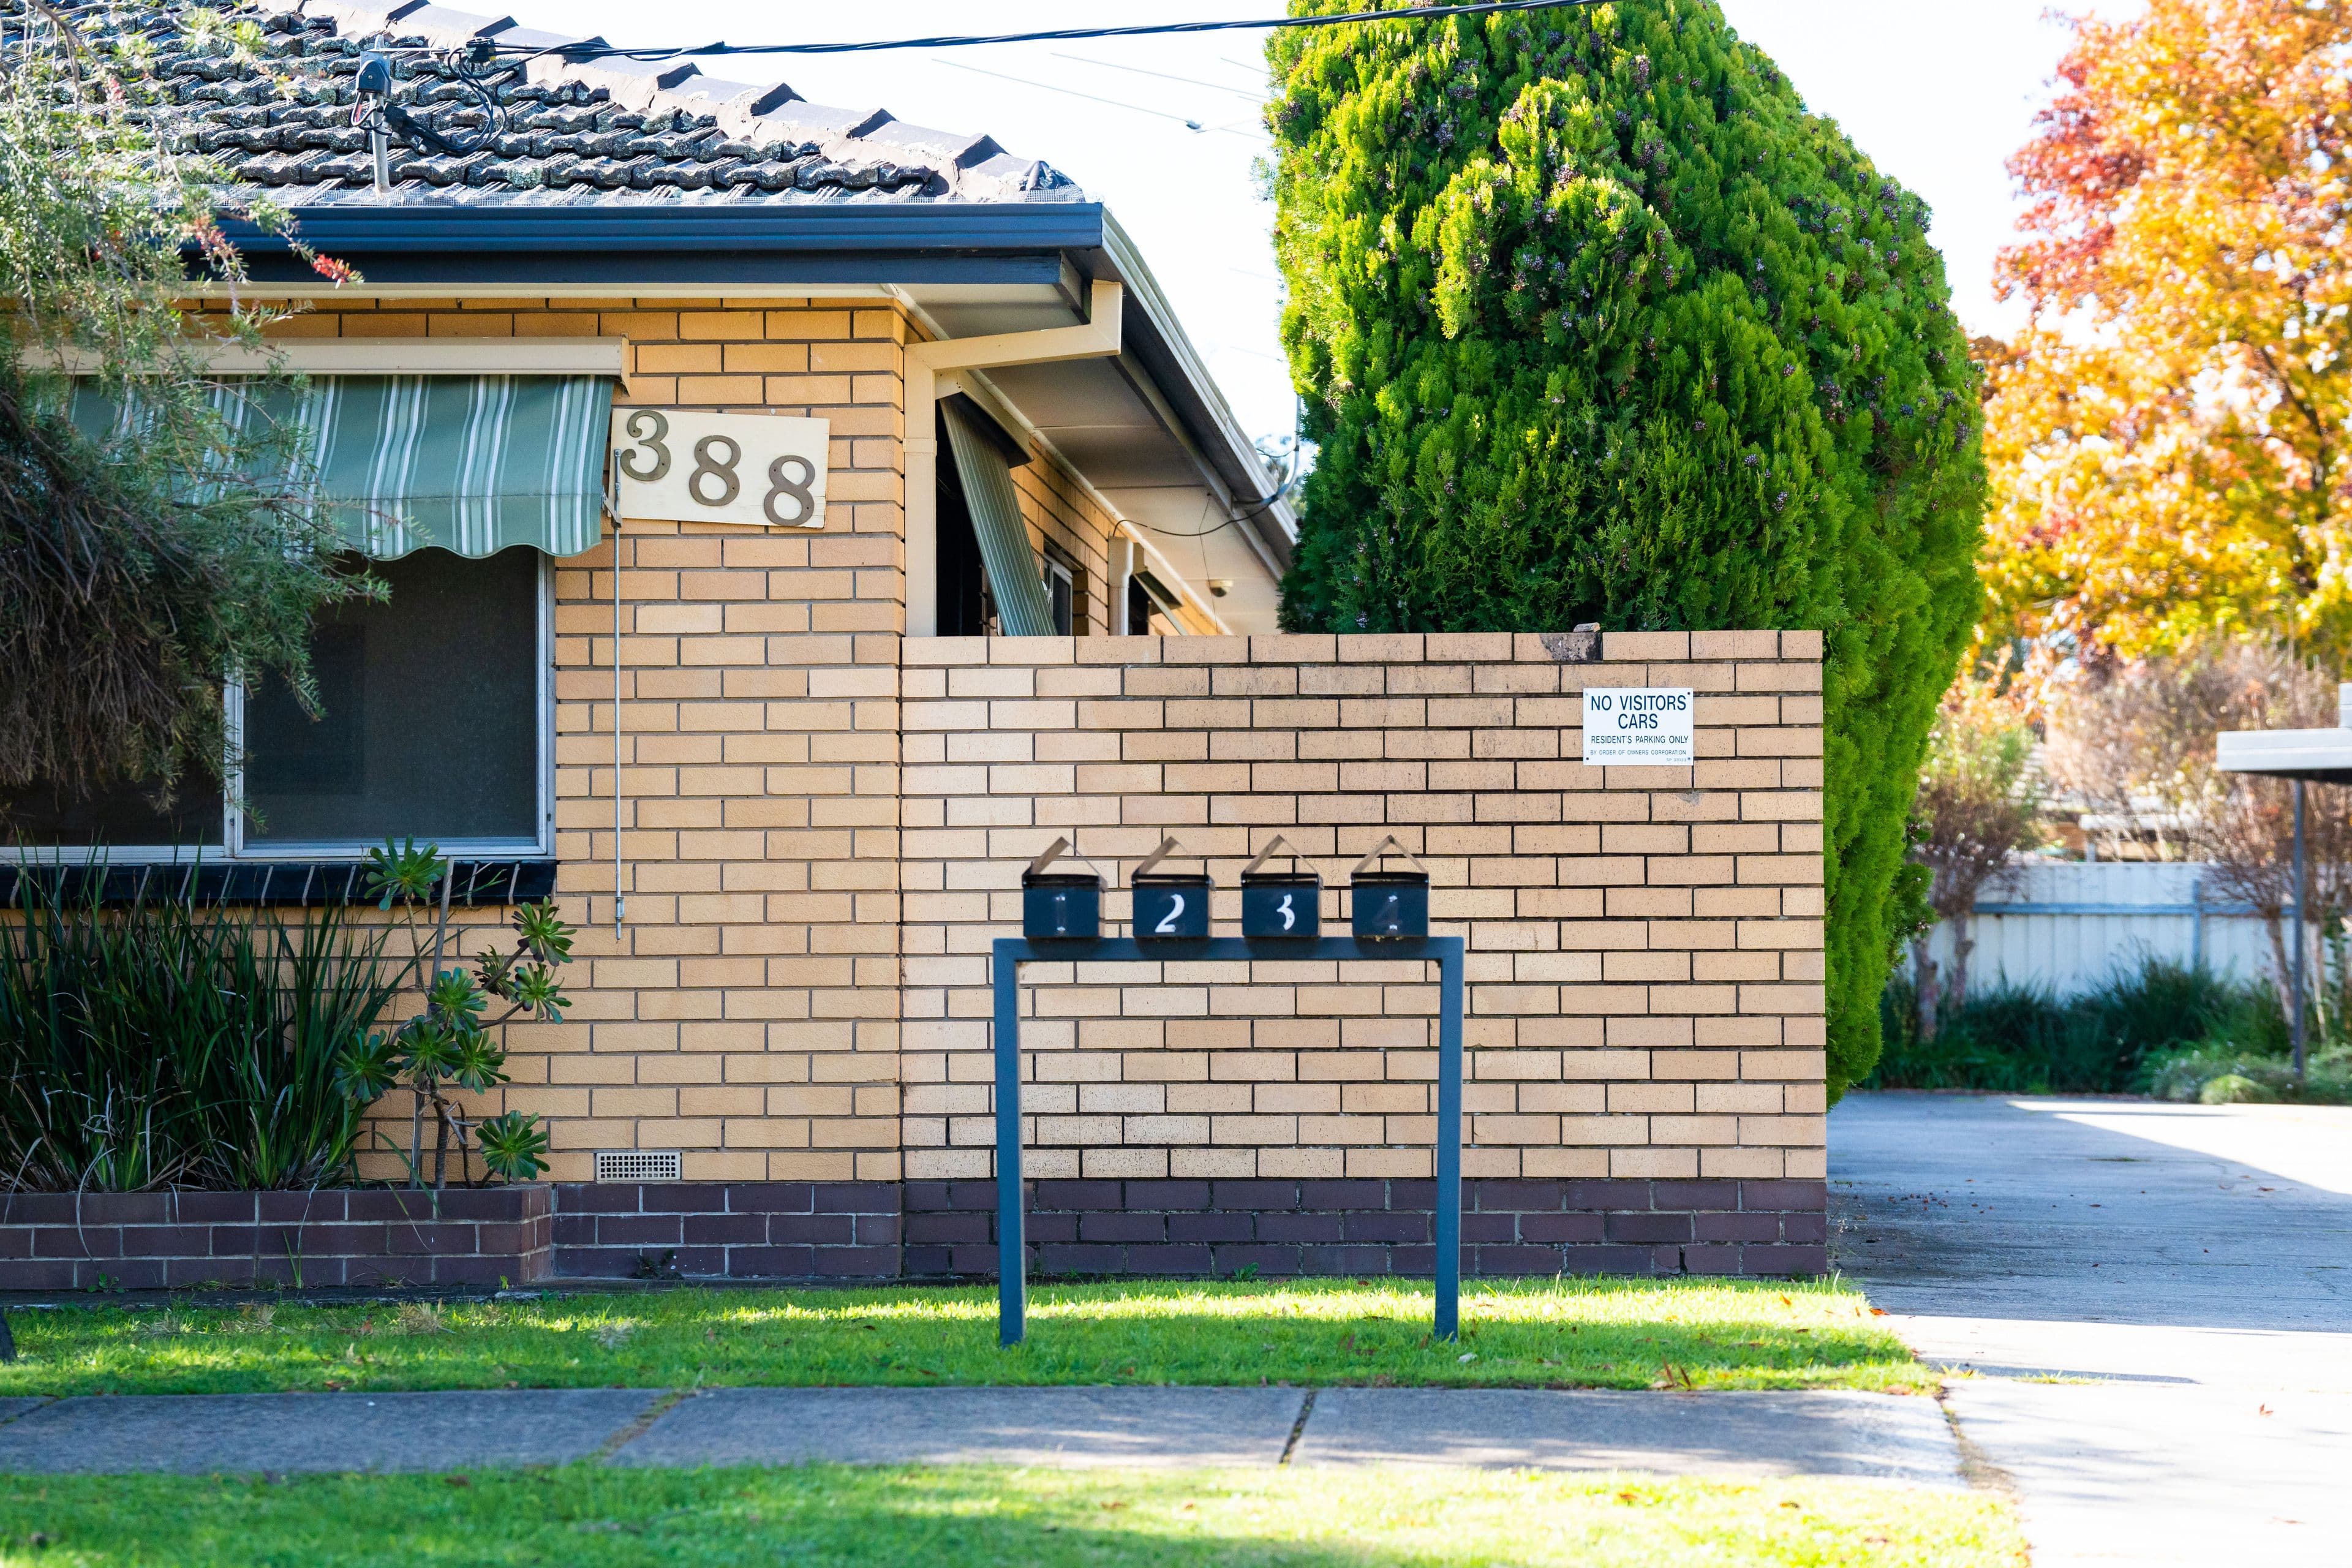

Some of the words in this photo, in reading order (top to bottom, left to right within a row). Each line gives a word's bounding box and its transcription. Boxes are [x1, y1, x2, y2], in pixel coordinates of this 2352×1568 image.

[620, 410, 816, 526] 388
[1591, 695, 1612, 710] NO
[1619, 695, 1686, 710] VISITORS
[1618, 713, 1658, 729] CARS
[1155, 894, 1185, 932] 2
[1276, 894, 1295, 930] 3
